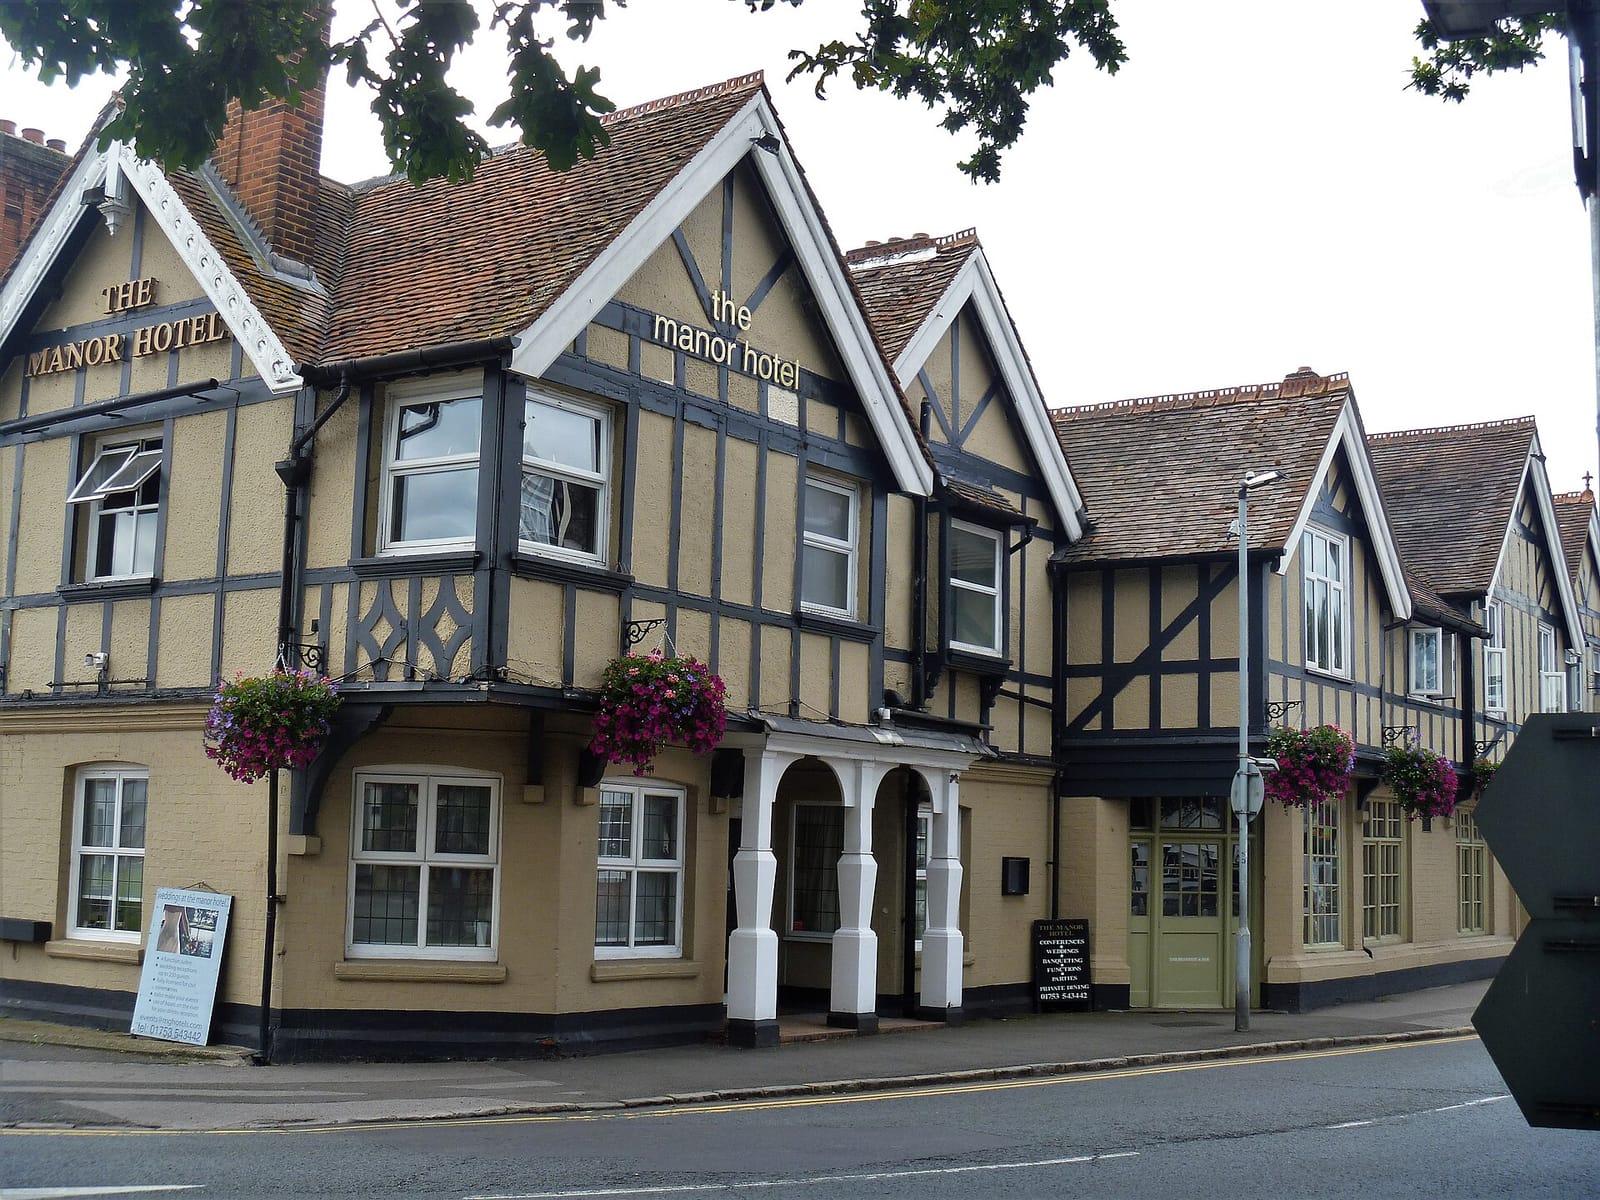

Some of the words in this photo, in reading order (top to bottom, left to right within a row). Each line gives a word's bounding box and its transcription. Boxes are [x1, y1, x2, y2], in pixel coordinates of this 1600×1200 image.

[102, 277, 158, 314] THE
[711, 289, 752, 331] the
[25, 333, 126, 378] MANOR
[132, 312, 229, 358] HOTEL
[654, 314, 736, 366] manor
[743, 340, 801, 390] hotel
[1061, 992, 1088, 1000] 543442
[150, 1024, 173, 1038] 01753
[174, 1028, 202, 1041] 543442
